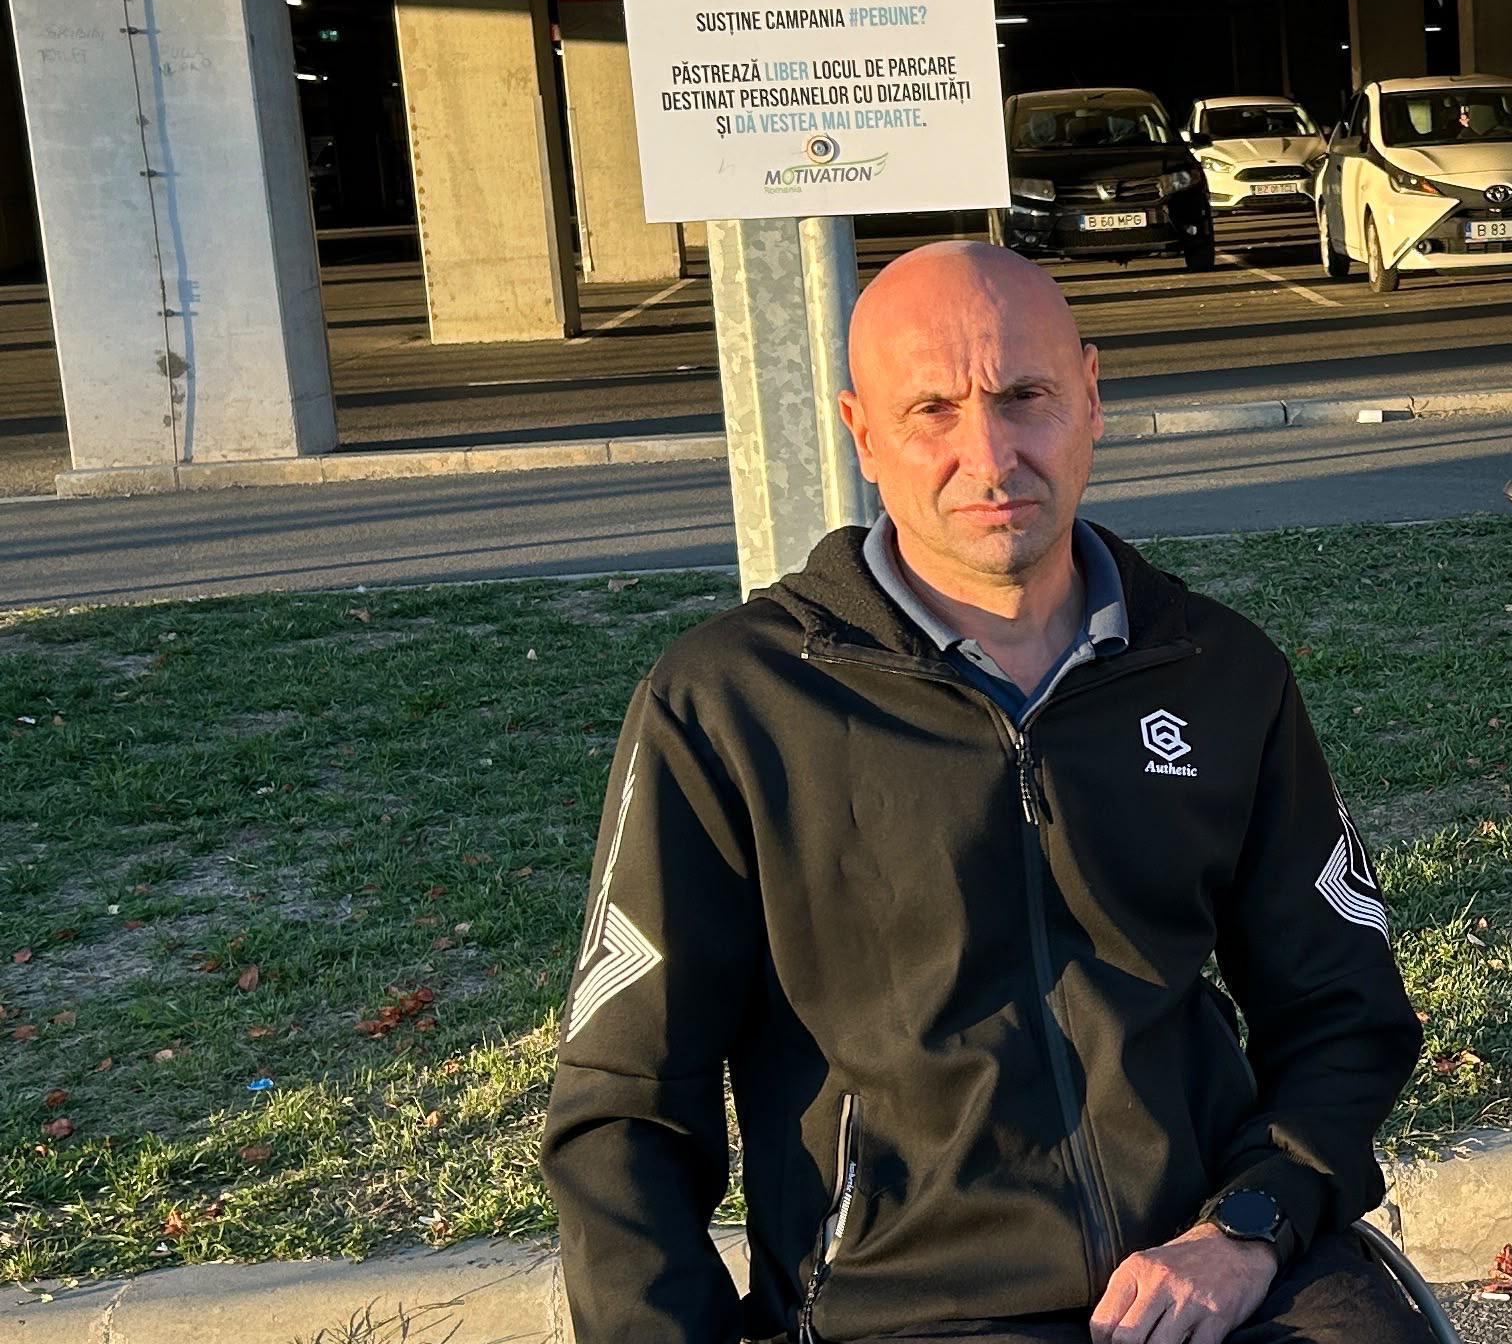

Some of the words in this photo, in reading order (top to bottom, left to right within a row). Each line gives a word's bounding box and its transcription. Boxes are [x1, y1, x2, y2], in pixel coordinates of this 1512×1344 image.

[696, 11, 762, 36] SUSȚINE
[765, 9, 846, 30] CAMPANIA
[849, 5, 928, 28] #PEBUNE?
[672, 58, 761, 84] PĂSTREAZĂ
[765, 61, 810, 82] LIBER
[813, 59, 861, 80] LOCUL
[864, 58, 886, 78] DE
[888, 56, 957, 77] PARCARE
[661, 90, 735, 111] DESTINAT
[740, 86, 850, 108] PERSOANELOR
[853, 84, 873, 103] CU
[877, 77, 971, 104] DIZABILITĂȚI
[716, 115, 732, 139] ȘI
[735, 110, 757, 134] DĂ
[759, 112, 819, 133] VESTEA
[822, 110, 851, 130] MAI
[854, 108, 928, 129] DEPARTE.
[764, 166, 872, 186] MOTIVATION
[1088, 216, 1097, 228] B
[1477, 223, 1486, 237] B
[1491, 223, 1506, 236] 83
[1145, 761, 1198, 777] Authetic
